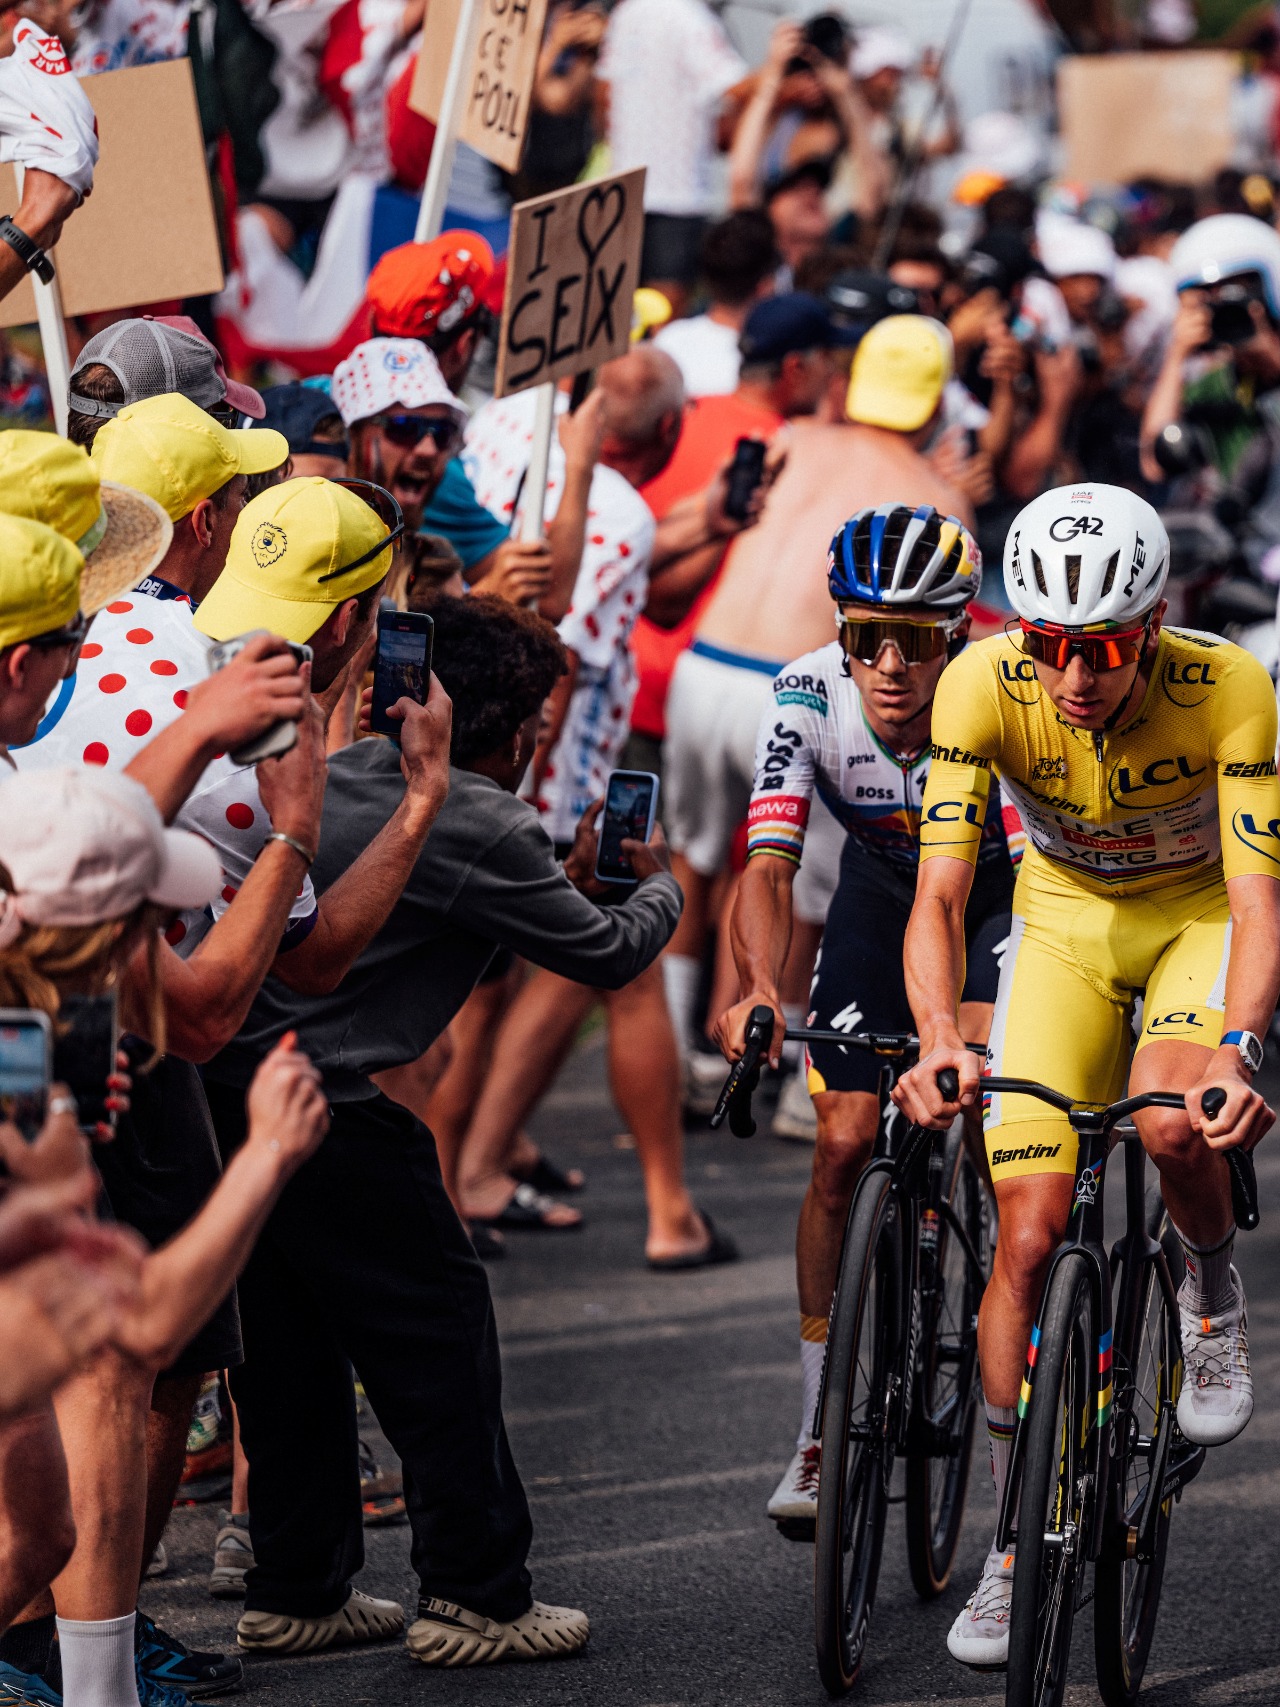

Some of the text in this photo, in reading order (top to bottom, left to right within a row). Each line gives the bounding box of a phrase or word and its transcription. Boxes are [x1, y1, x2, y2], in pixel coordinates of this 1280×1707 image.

[528, 205, 556, 281] I
[508, 260, 626, 387] SEIX
[1049, 516, 1104, 543] G42
[1011, 530, 1027, 592] MET
[1123, 530, 1147, 598] MET
[1168, 661, 1217, 685] LCL
[774, 675, 828, 700] BORA
[760, 722, 803, 791] BOSS
[932, 743, 989, 768] antini
[1118, 756, 1207, 793] LCL
[856, 785, 895, 801] BOSS
[748, 801, 798, 819] mewa
[1055, 814, 1153, 838] UAE
[1065, 846, 1157, 866] XRG
[1151, 1011, 1204, 1029] LCL
[991, 1143, 1063, 1167] Santini
